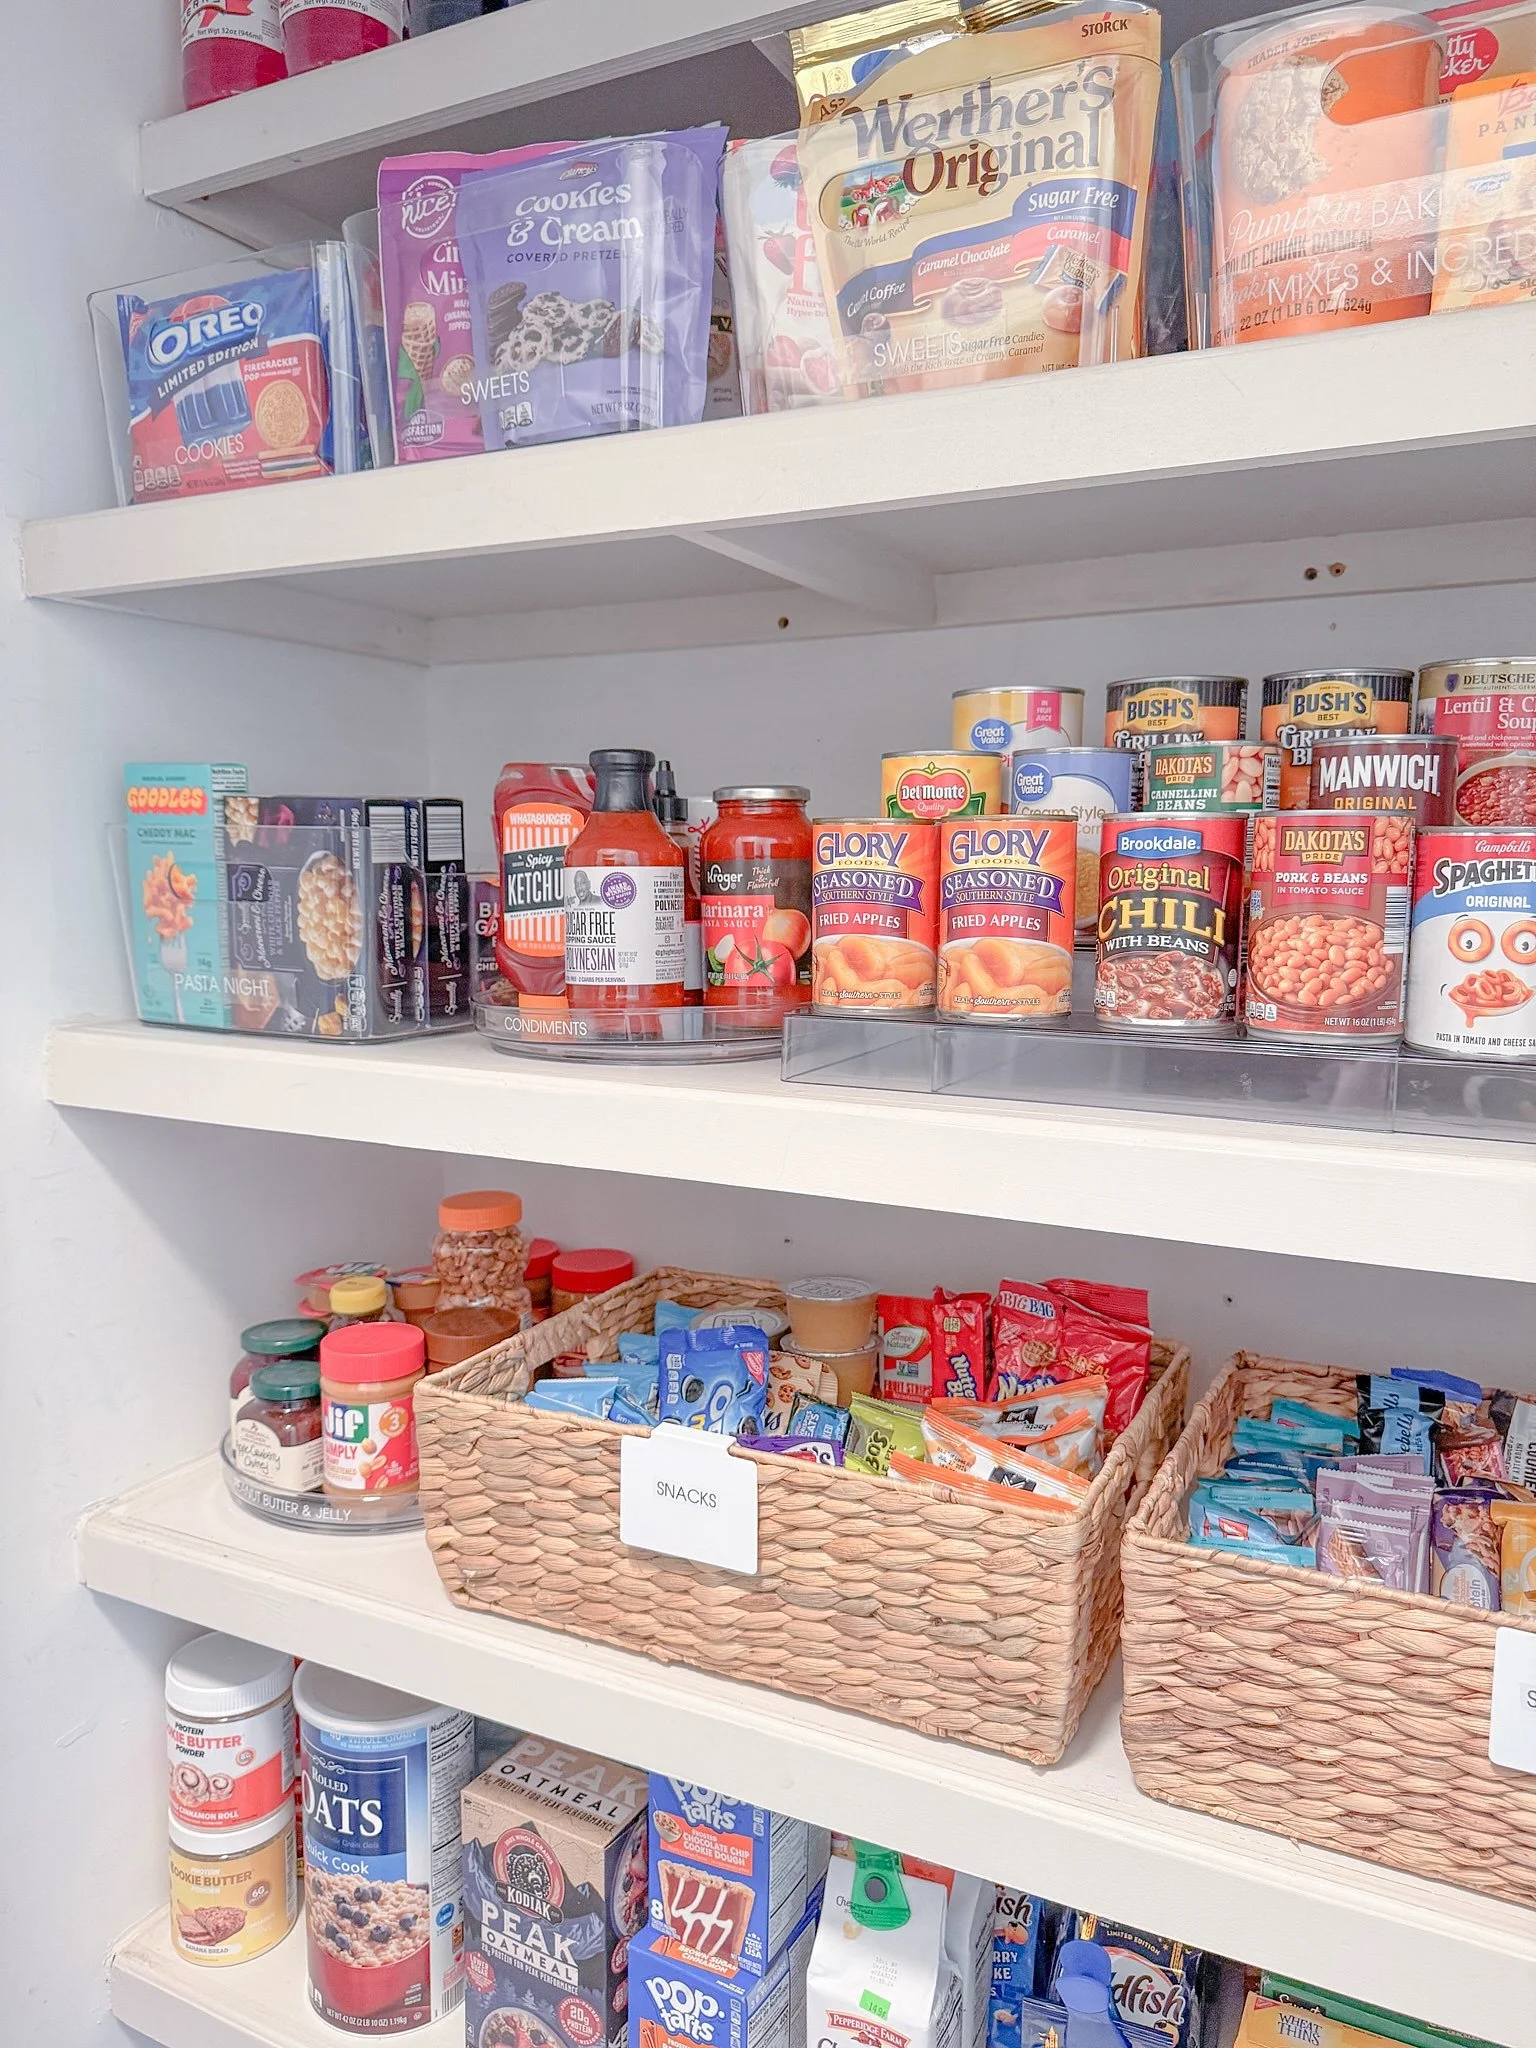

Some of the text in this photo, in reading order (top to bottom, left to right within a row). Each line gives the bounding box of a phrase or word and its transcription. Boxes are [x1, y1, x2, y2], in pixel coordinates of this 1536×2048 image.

[1081, 19, 1128, 38] STORCK
[902, 108, 1100, 197] Original
[515, 182, 632, 217] Cookies
[1028, 186, 1120, 212] Sugar Free
[507, 215, 645, 247] & Cream
[1046, 226, 1101, 244] Caramel
[1224, 194, 1363, 262] Pumpkin
[507, 249, 568, 264] COVERED
[918, 243, 1010, 277] Caramel Chocolate
[870, 281, 906, 301] Coffee
[1268, 262, 1358, 306] MIXES
[1370, 257, 1392, 286] &
[1240, 301, 1301, 331] 22 OZ LB
[150, 303, 263, 366] OREO
[1011, 331, 1046, 345] Candies
[874, 331, 964, 368] SWEETS
[1008, 343, 1044, 358] Caramel
[157, 337, 259, 398] LIMITED EDITION
[461, 370, 530, 406] SWEETS
[175, 432, 245, 465] COOKIES
[1127, 697, 1194, 722] BUSH'S
[1293, 690, 1368, 717] BUSH'S
[1443, 697, 1515, 715] Lentil &
[1035, 714, 1052, 722] JUICE
[1147, 718, 1167, 727] BEST
[1317, 713, 1339, 721] BEST
[974, 726, 1005, 738] Great
[981, 735, 1007, 745] Value
[1154, 755, 1213, 776] DAKOTA'S
[1319, 754, 1440, 797] MANWICH
[1017, 772, 1044, 787] Great
[1166, 775, 1192, 783] PRIDE
[901, 784, 965, 800] Del Monte
[1021, 784, 1046, 795] Value
[1151, 788, 1218, 799] CANNELLINI
[917, 802, 946, 812] Quality
[1070, 805, 1106, 819] Style
[1156, 799, 1207, 811] BEANS
[1334, 796, 1417, 810] ORIGINAL
[509, 813, 573, 826] WHATABURGER
[137, 827, 197, 839] CHEDDY MAC
[1121, 835, 1197, 851] Brookdale
[1284, 830, 1366, 852] DAKOTA'S
[816, 832, 909, 868] GLORY
[949, 828, 1050, 867] GLORY
[1305, 852, 1340, 861] PRIDE
[1475, 839, 1531, 855] Campbell's
[525, 853, 554, 869] Spicy
[974, 858, 1021, 866] FOODS
[707, 864, 744, 892] Kroger
[814, 871, 916, 900] SEASONED
[945, 870, 1055, 899] SEASONED
[1107, 862, 1211, 892] Original
[1275, 872, 1369, 884] PORK & BEANS
[822, 890, 895, 903] SOUTHERN STYLE
[955, 890, 1035, 904] SOUTHERN STYLE
[1277, 886, 1365, 896] IN TOMATO SAUCE
[1465, 894, 1531, 909] ORIGINAL
[589, 911, 616, 936] FREE
[723, 919, 758, 928] SAUCE
[819, 912, 901, 929] FRIED APPLES
[952, 914, 1041, 931] FRIED APPLES
[1098, 896, 1226, 947] CHILI
[587, 936, 617, 944] SAUCE
[1105, 934, 1210, 955] WITH BEANS
[174, 973, 270, 997] PASTA NIGHT
[839, 989, 874, 999] Southern
[974, 996, 1011, 1007] Southern
[504, 1016, 588, 1036] CONDIMENTS
[1324, 1016, 1370, 1027] NET WT 16 OZ
[1435, 1032, 1527, 1047] PASTA IN TOMATO AND CHEESE
[1000, 1290, 1055, 1318] BIG BAG
[890, 1331, 915, 1344] Simply
[656, 1480, 717, 1508] SNACKS
[262, 1495, 352, 1521] BUTTER & JELLY
[175, 1721, 205, 1736] PROTEIN
[175, 1744, 205, 1758] POWDER
[187, 1735, 242, 1750] BUTTER
[312, 1766, 349, 1793] ROLLED
[506, 1737, 647, 1807] PEAK
[499, 1762, 620, 1818] OATMEAL
[301, 1769, 384, 1837] OATS
[493, 1778, 616, 1833] PROTEIN FOR PEAK PERFORMANCE
[217, 1811, 240, 1820] ROLL
[681, 1799, 736, 1831] tarts
[683, 1832, 750, 1859] CHOCOLATE CHIP
[683, 1842, 745, 1867] COOKIE DOUGH
[331, 1856, 370, 1875] Cook
[203, 1870, 253, 1887] BUTTER
[505, 1886, 552, 1922] KODIAK
[651, 1899, 664, 1921] 8
[480, 1900, 579, 1968] PEAK
[1106, 1930, 1161, 1956] LIMITED EDITION
[469, 1954, 489, 1970] LOWER
[486, 1933, 574, 1982] OATMEAL
[679, 1944, 709, 1961] BROWN
[710, 1956, 739, 1972] SUGAR
[682, 1952, 728, 1973] CINNAMON
[745, 1948, 763, 1960] USA
[491, 1947, 579, 1996] PROTEIN FOR PEAK PERFORMANCE
[343, 2013, 389, 2027] 42 OZ LB OZ)
[569, 2004, 590, 2026] 20g
[660, 2008, 715, 2041] tarts
[1278, 2012, 1324, 2035] WHEAT
[567, 2018, 593, 2036] PROTEIN
[833, 2014, 903, 2046] PEPPERIDGE FARM
[1277, 2021, 1321, 2047] THINS
